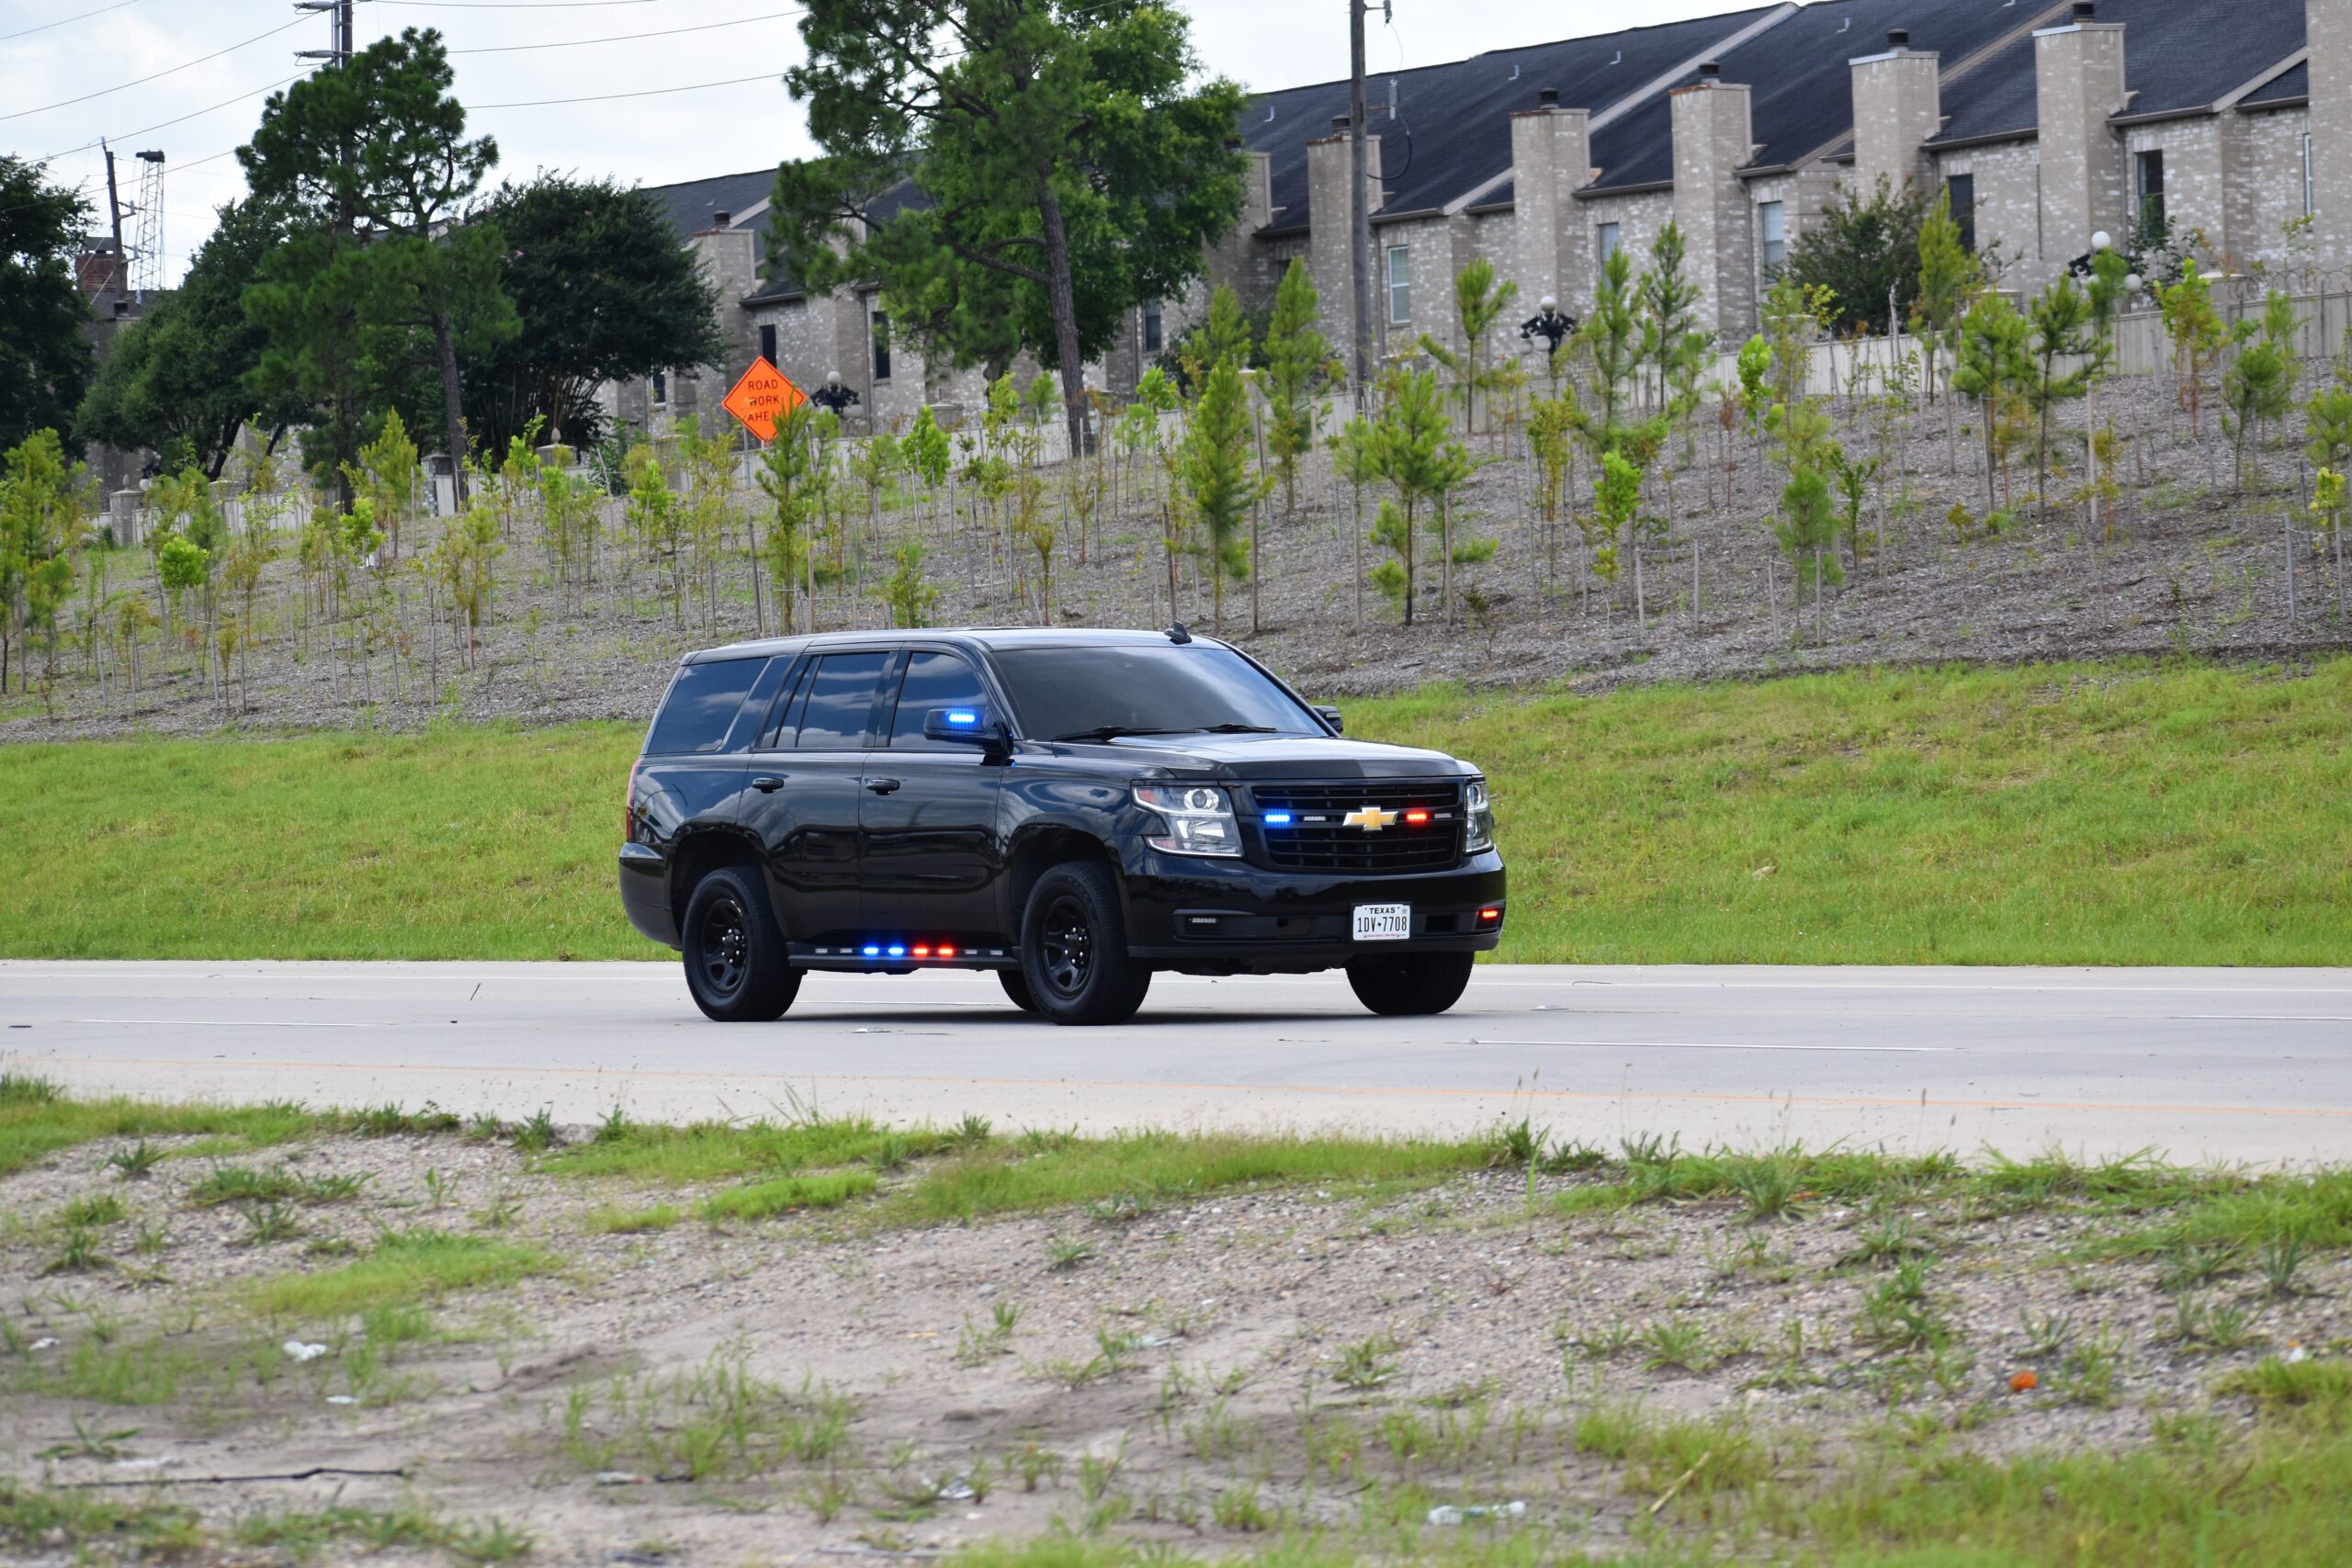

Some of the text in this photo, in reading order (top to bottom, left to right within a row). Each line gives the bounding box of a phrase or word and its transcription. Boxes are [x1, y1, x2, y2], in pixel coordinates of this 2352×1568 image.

[748, 379, 778, 390] ROAD
[749, 395, 779, 406] WORK
[747, 411, 780, 422] AHE
